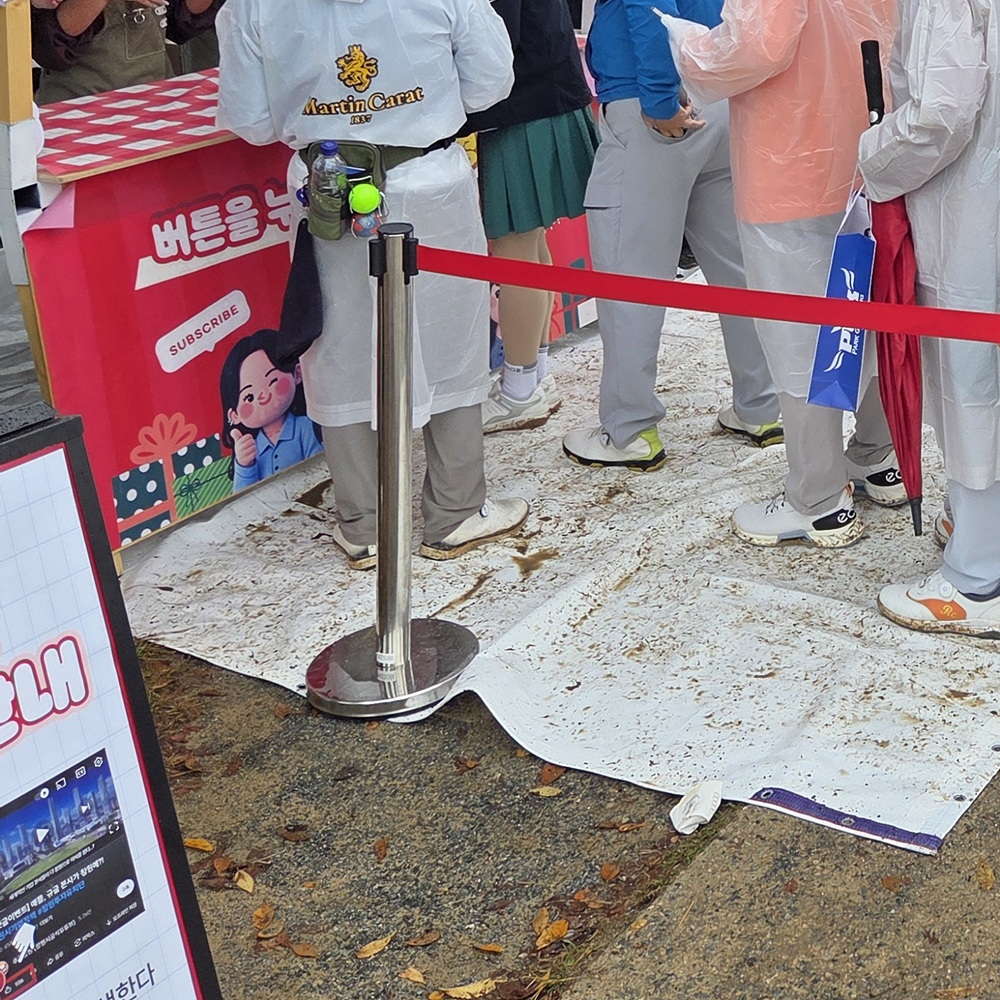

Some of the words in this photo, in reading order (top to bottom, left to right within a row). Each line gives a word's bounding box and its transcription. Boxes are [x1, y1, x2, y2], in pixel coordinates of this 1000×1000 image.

[302, 94, 367, 115] Martin
[367, 86, 424, 111] Carat
[152, 195, 259, 258] 버튼을
[169, 304, 239, 356] SUBSCRIBE
